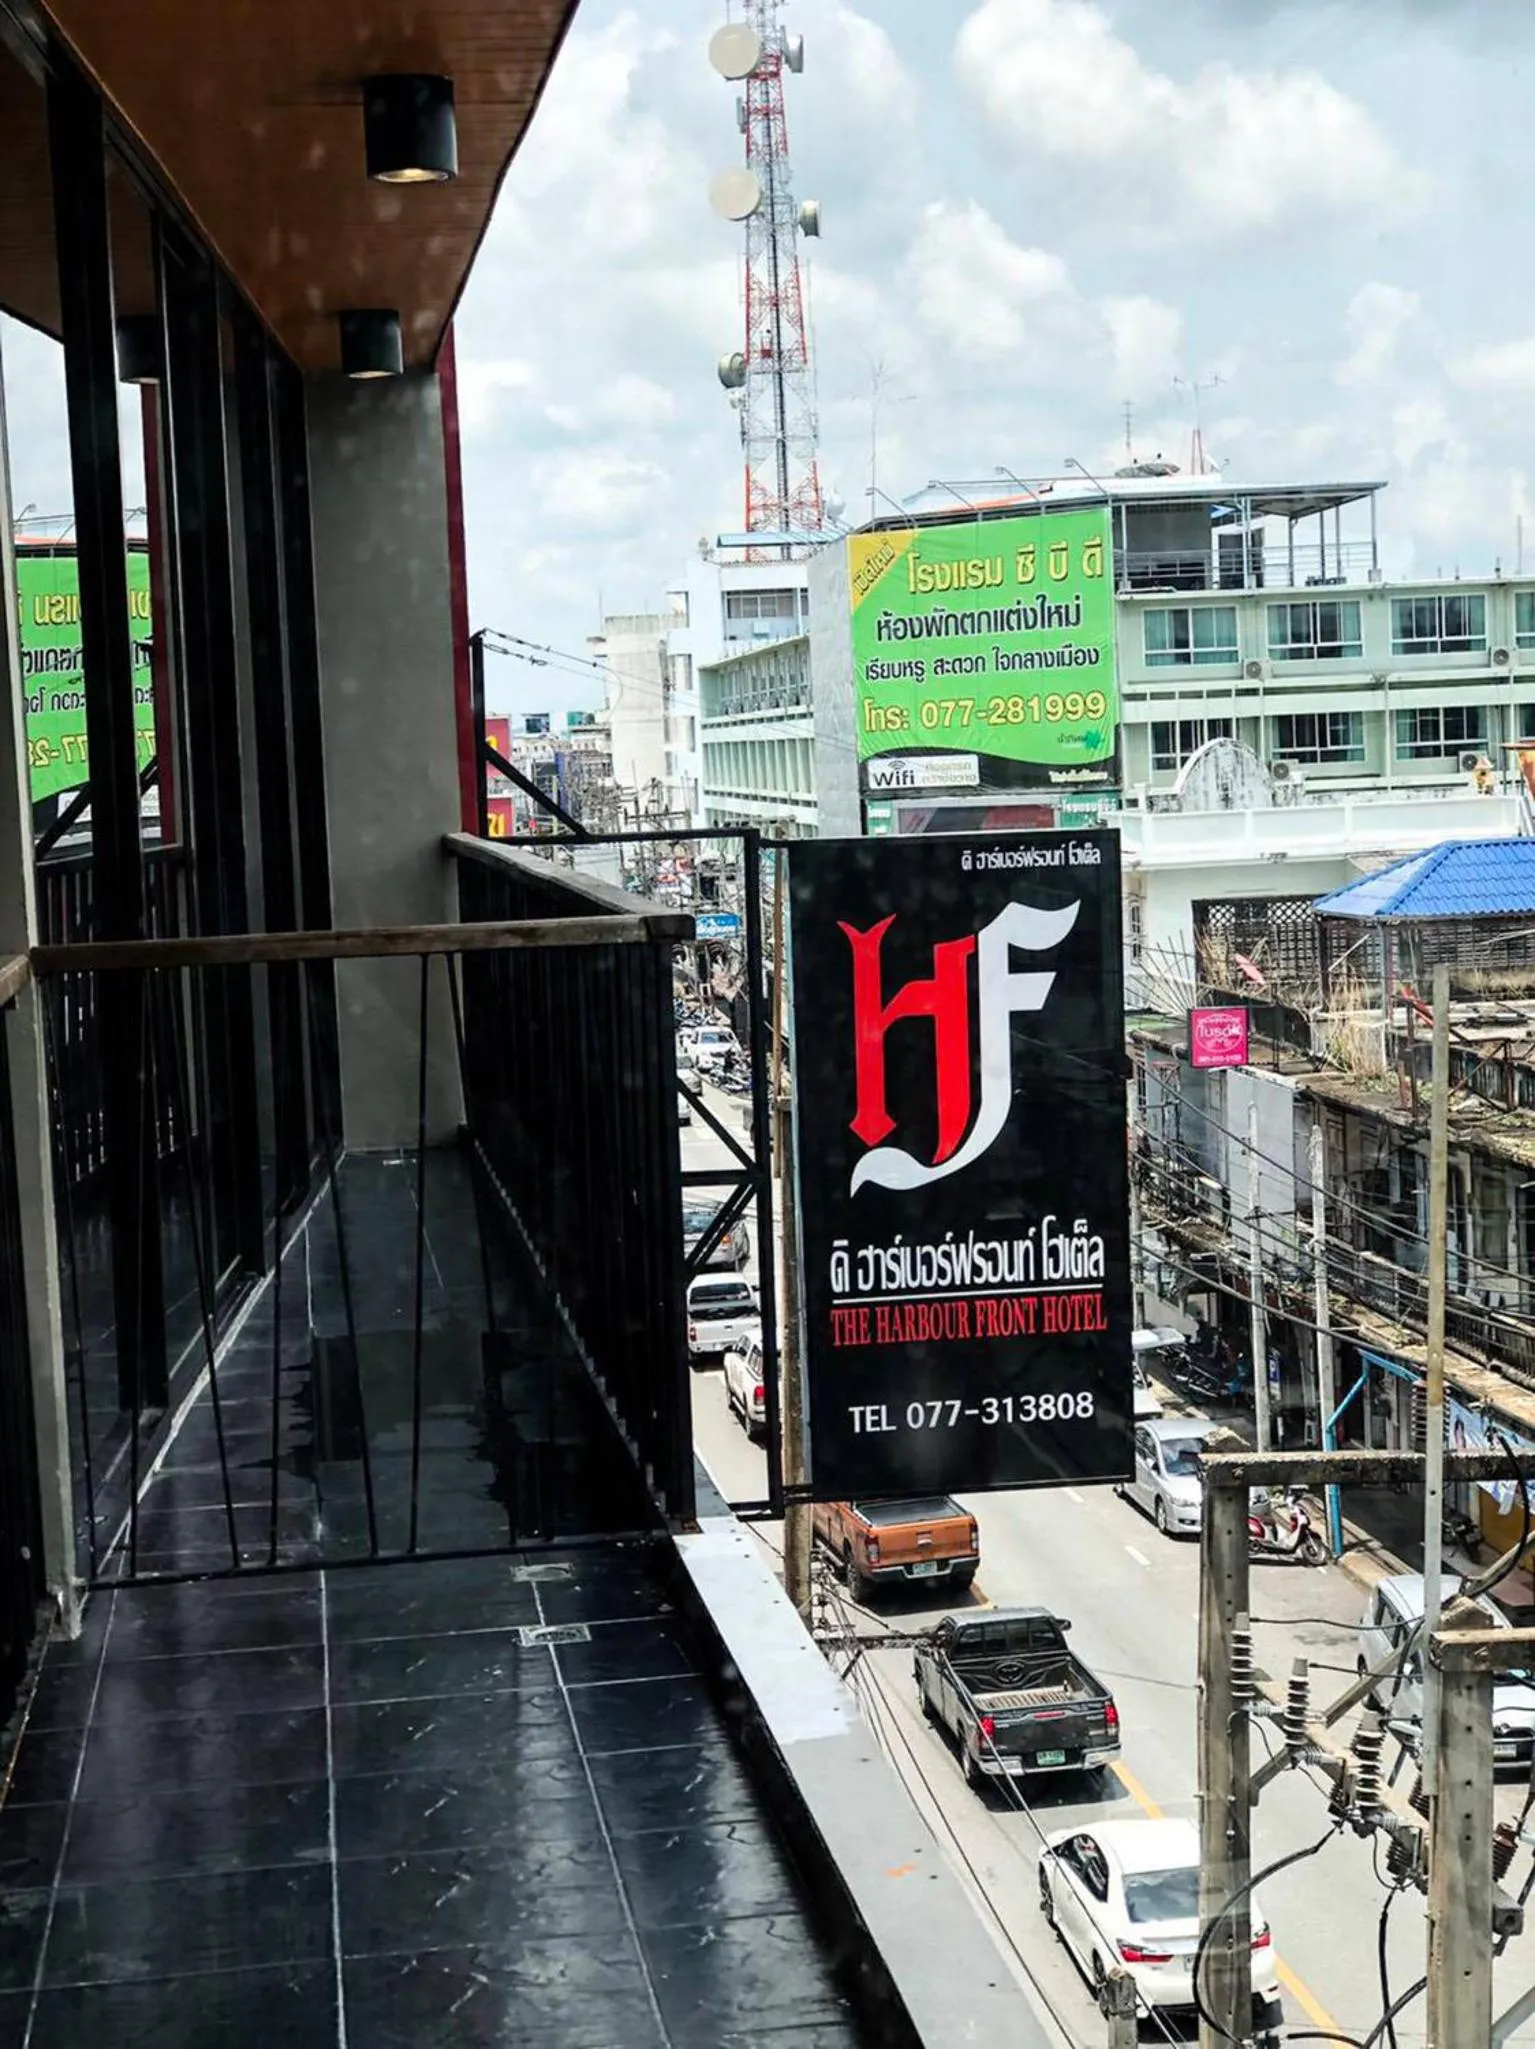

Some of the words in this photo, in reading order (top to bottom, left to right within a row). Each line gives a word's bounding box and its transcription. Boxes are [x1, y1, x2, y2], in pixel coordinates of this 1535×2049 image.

[907, 553, 1004, 593] โรงแรม
[1049, 540, 1068, 581] บี
[1082, 536, 1103, 578] ดี
[877, 594, 1082, 642] ห้องพักตกแต่งใหม่
[865, 656, 926, 683] เรียบหรู
[934, 654, 986, 676] สะดวก
[992, 644, 1100, 672] ใจกลางเมือง
[863, 697, 911, 732] โทร:
[919, 690, 1107, 730] 077-281999
[873, 770, 916, 786] Wifi
[1068, 840, 1101, 866] โฮเต็ล
[836, 899, 1081, 1198] HF
[830, 1239, 850, 1293] ดิ
[857, 1228, 1036, 1291] ฮาร์เบอร์ฟรอนท์
[1041, 1215, 1104, 1281] โฮเต็ล
[830, 1308, 872, 1347] THE
[875, 1300, 971, 1344] HARBOUR
[974, 1296, 1038, 1338] FRONT
[1043, 1293, 1108, 1333] HOTEL
[848, 1406, 897, 1433] TEL
[905, 1391, 1095, 1429] 077-313808
